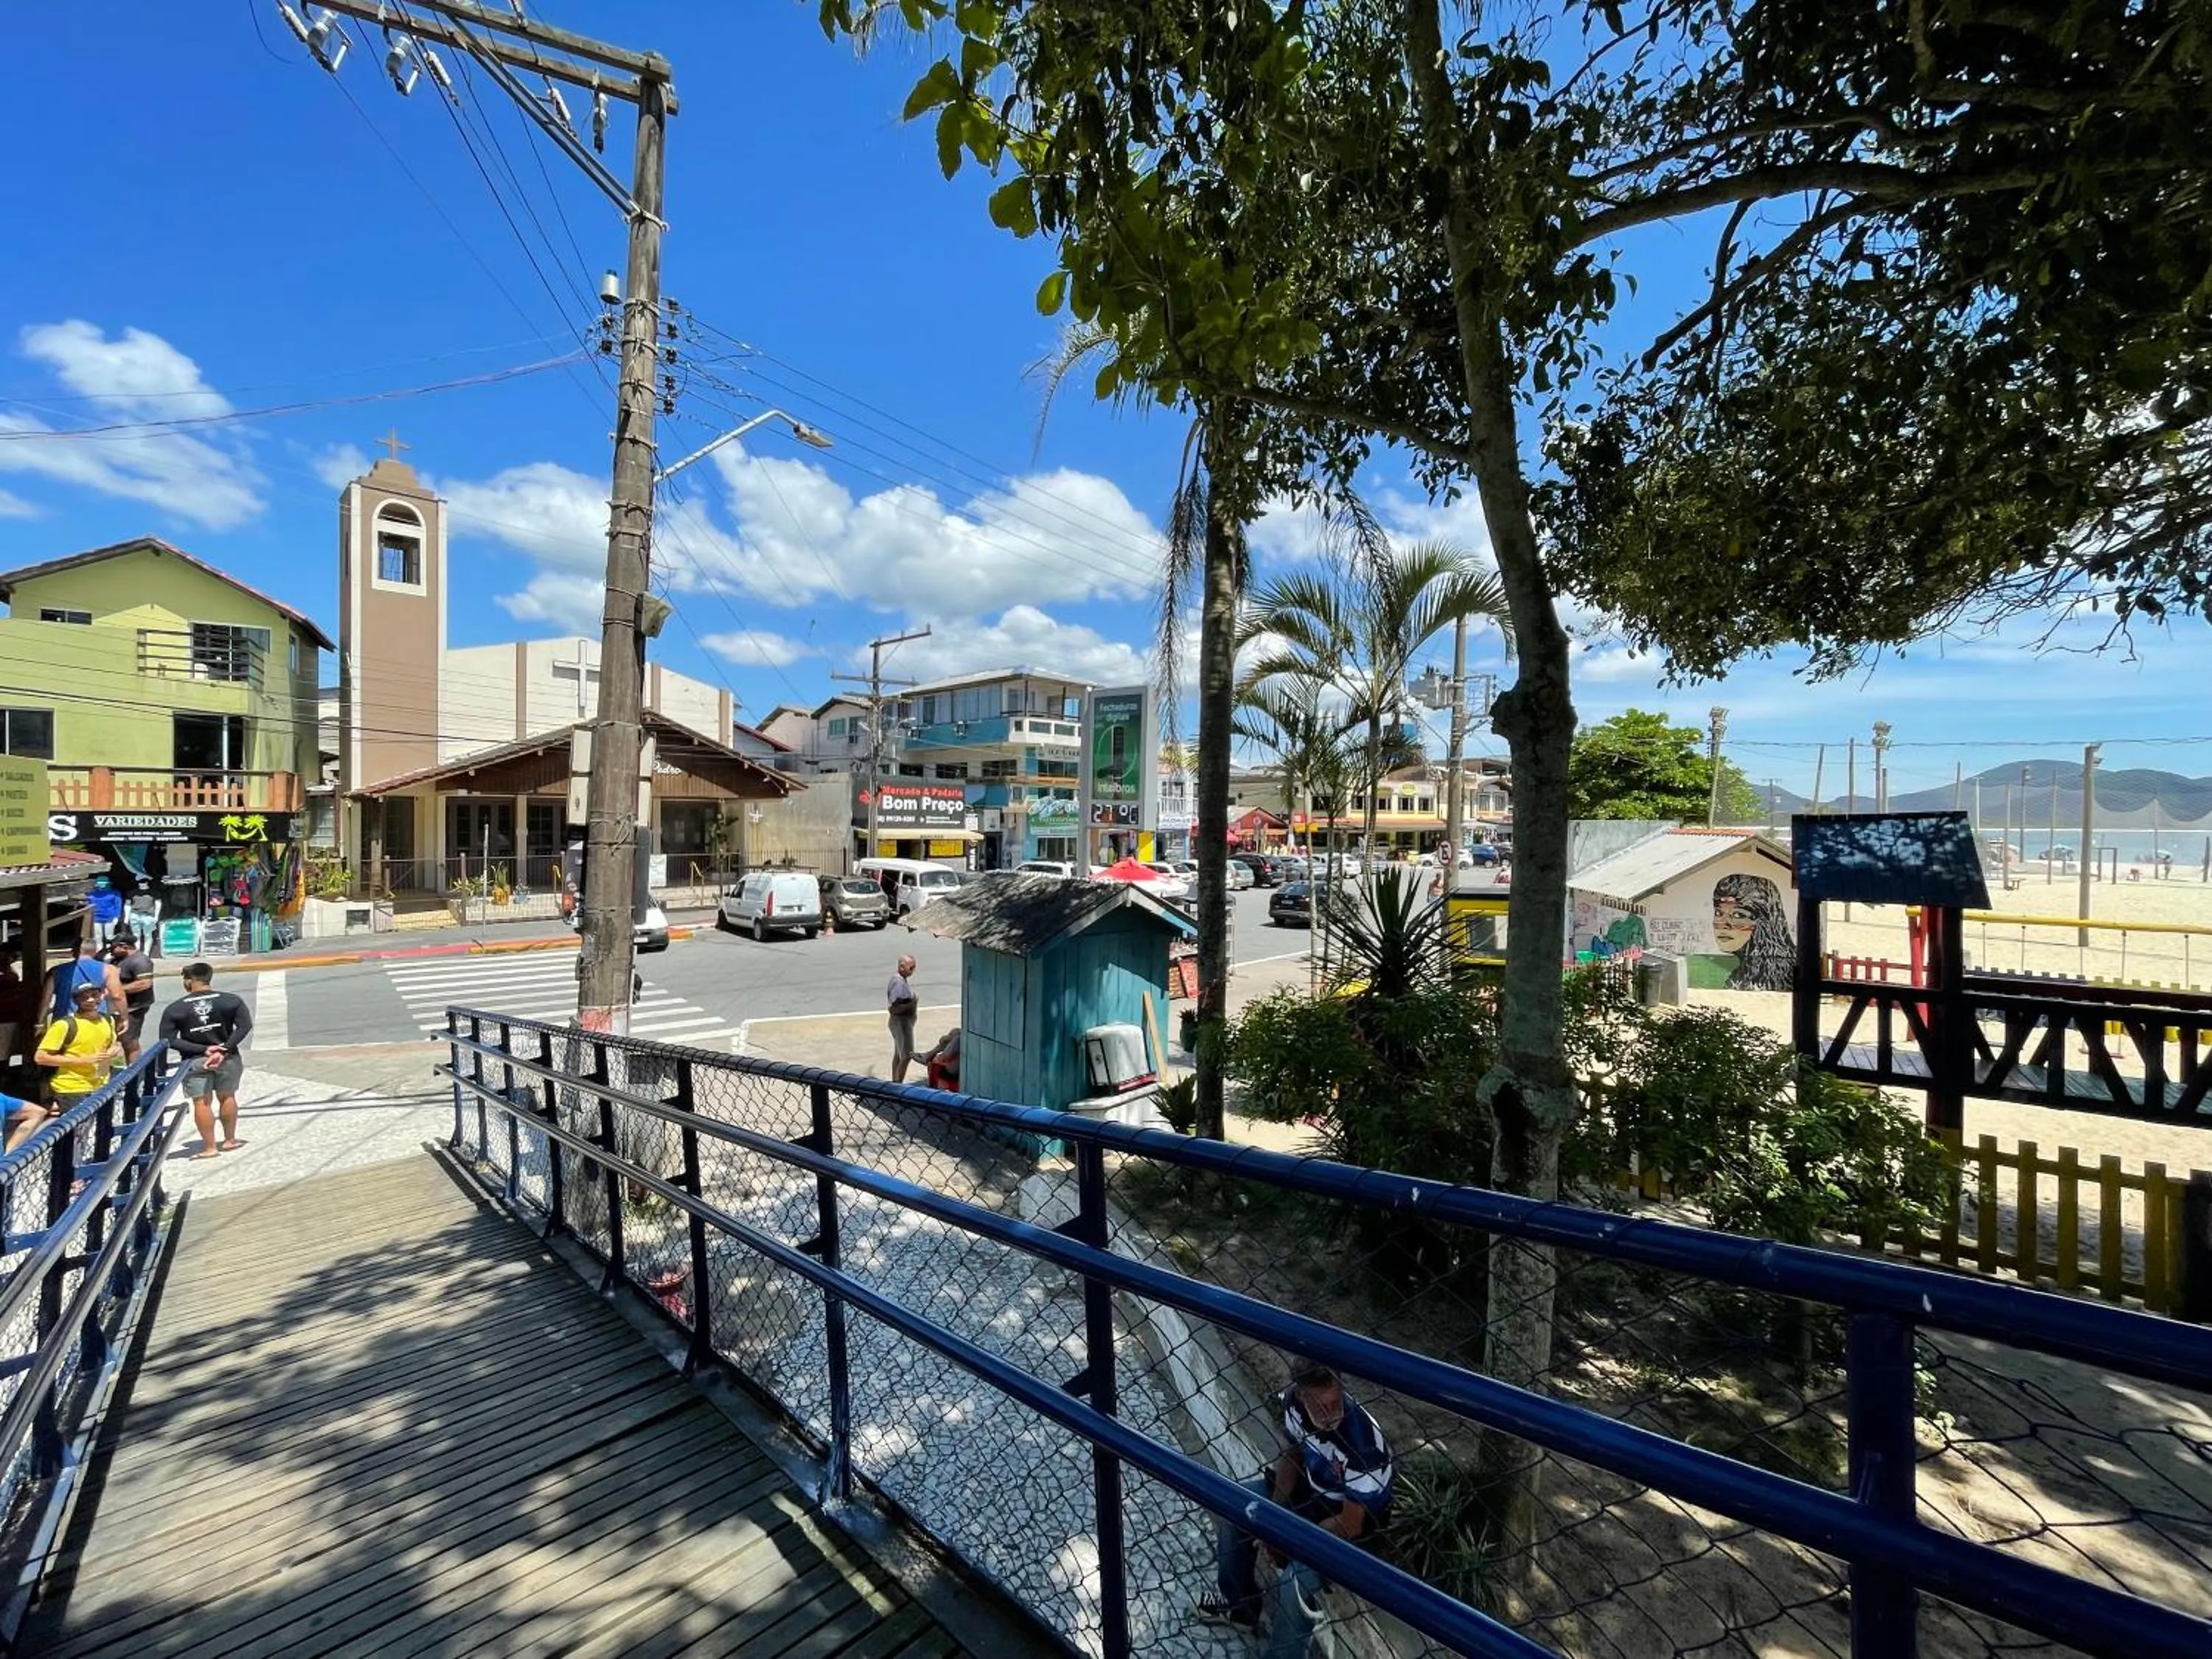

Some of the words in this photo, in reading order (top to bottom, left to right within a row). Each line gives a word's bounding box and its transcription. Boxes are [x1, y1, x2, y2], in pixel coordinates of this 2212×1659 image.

[883, 786, 921, 796] Mercado
[931, 788, 964, 797] Padaria
[883, 795, 918, 810] Bom
[922, 796, 964, 814] Preço
[94, 815, 198, 827] VARIEDADES
